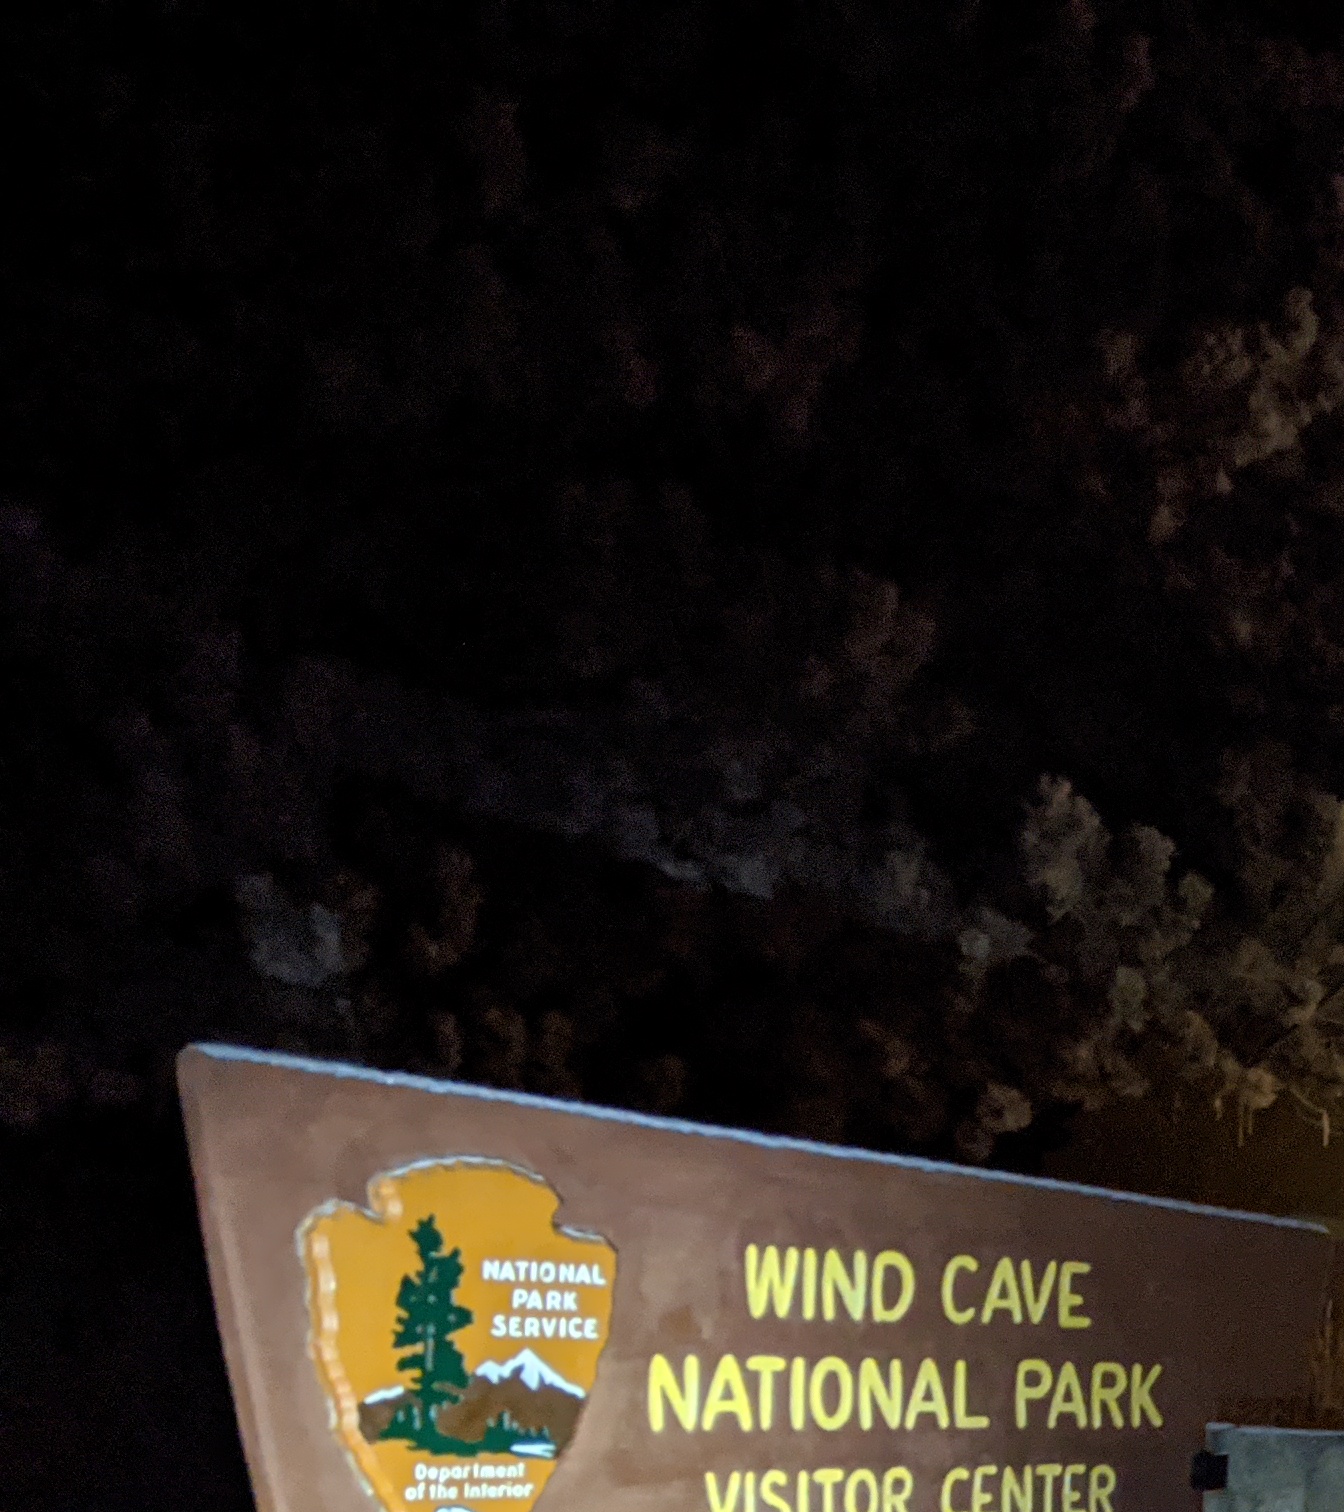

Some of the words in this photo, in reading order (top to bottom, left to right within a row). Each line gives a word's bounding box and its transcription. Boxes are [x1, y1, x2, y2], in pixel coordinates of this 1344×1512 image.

[482, 1259, 607, 1286] NATIONAL
[745, 1244, 916, 1322] WIND
[941, 1255, 1092, 1328] CAVE
[512, 1288, 578, 1311] PARK
[491, 1314, 599, 1339] SERVICE
[647, 1354, 989, 1432] NATIONAL
[1015, 1359, 1163, 1430] PARK
[414, 1462, 526, 1483] Department
[404, 1482, 426, 1501] of
[428, 1483, 459, 1500] the
[463, 1481, 535, 1499] Interior
